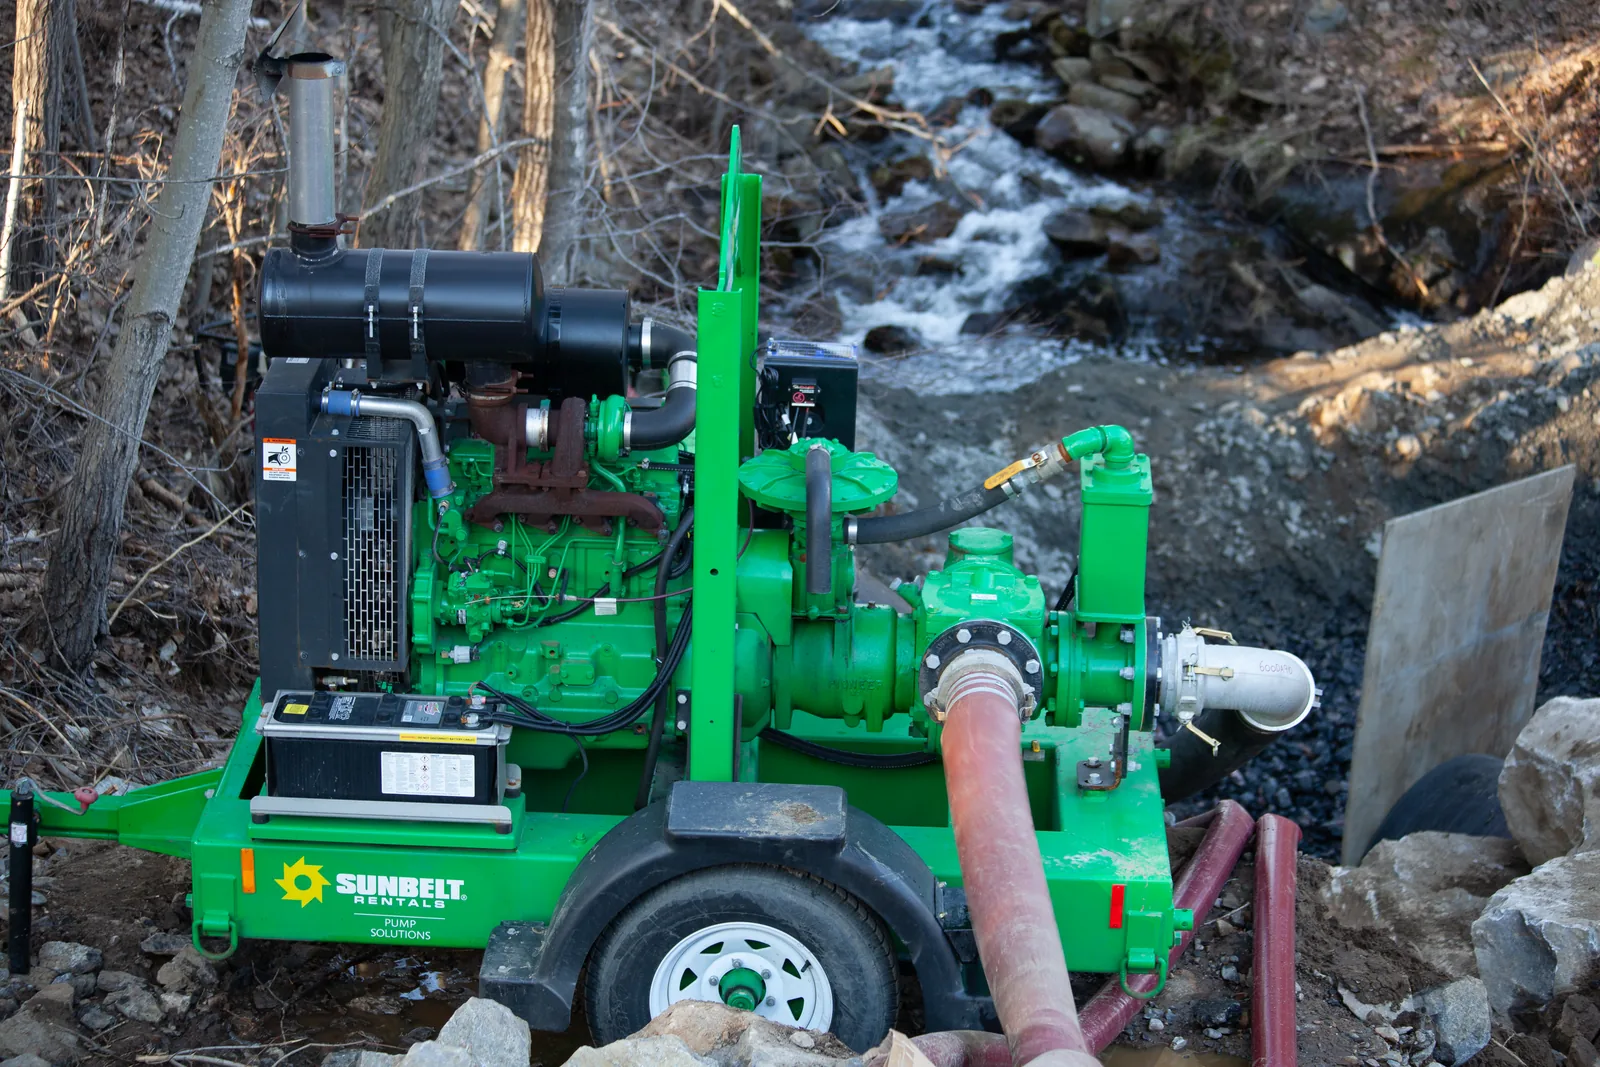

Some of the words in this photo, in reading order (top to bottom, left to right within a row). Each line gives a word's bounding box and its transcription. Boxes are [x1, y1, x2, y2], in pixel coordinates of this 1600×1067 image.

[354, 896, 445, 908] RENTALS
[384, 918, 417, 928] PUMP
[370, 928, 431, 941] SOLUTIONS
